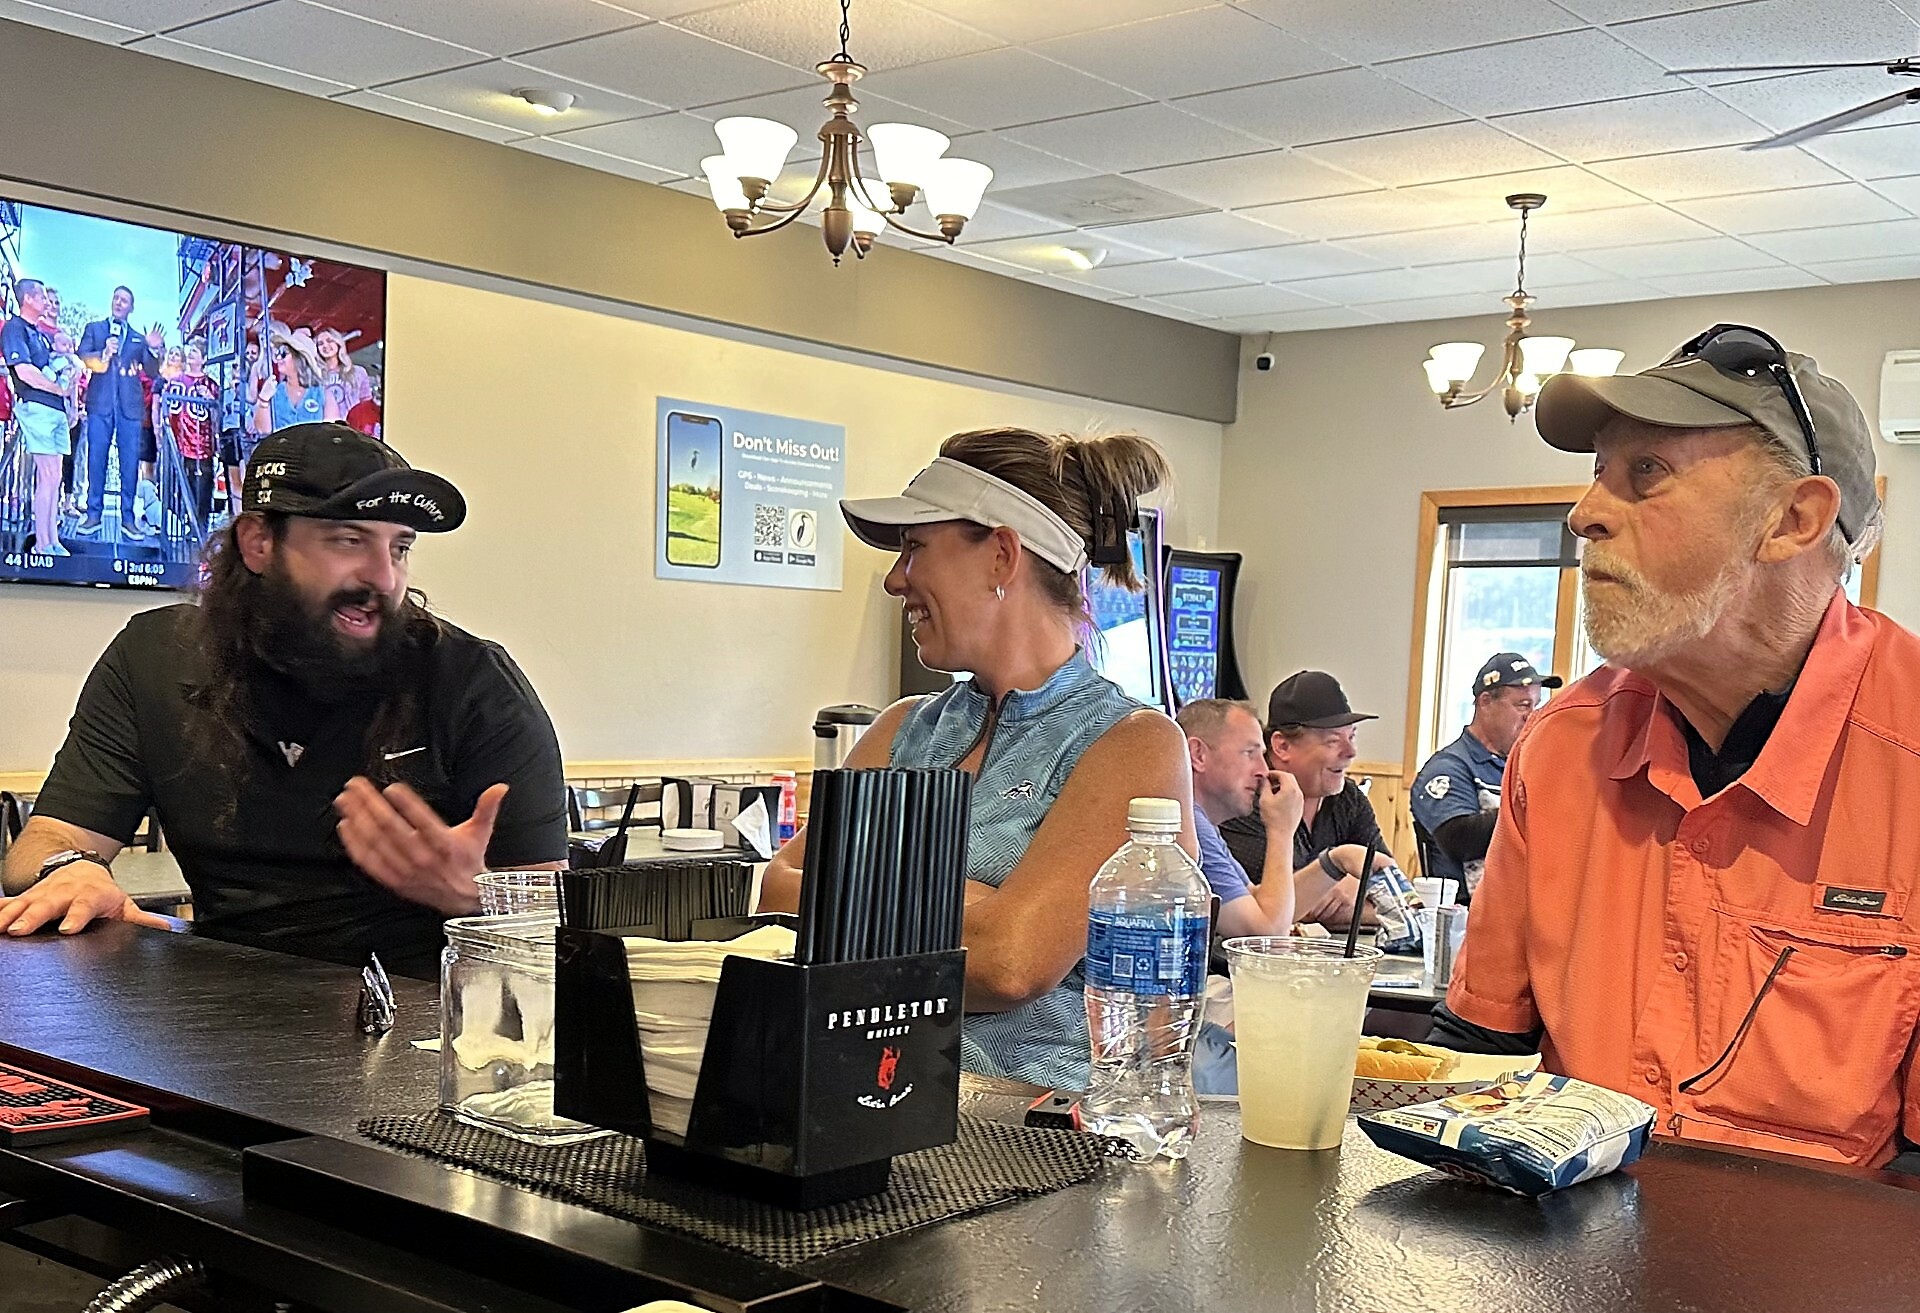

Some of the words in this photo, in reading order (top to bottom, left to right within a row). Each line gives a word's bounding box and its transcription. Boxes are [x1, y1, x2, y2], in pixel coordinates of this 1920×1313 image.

[733, 432, 773, 453] Don't
[776, 438, 807, 457] Miss
[810, 443, 839, 462] Out!
[388, 491, 411, 503] the
[5, 553, 22, 566] 44
[30, 555, 54, 568] UAB
[129, 562, 143, 573] 3rd
[1114, 917, 1156, 930] AQUAFINA
[827, 998, 948, 1029] PENDLETON
[866, 1025, 910, 1040] WHISKY
